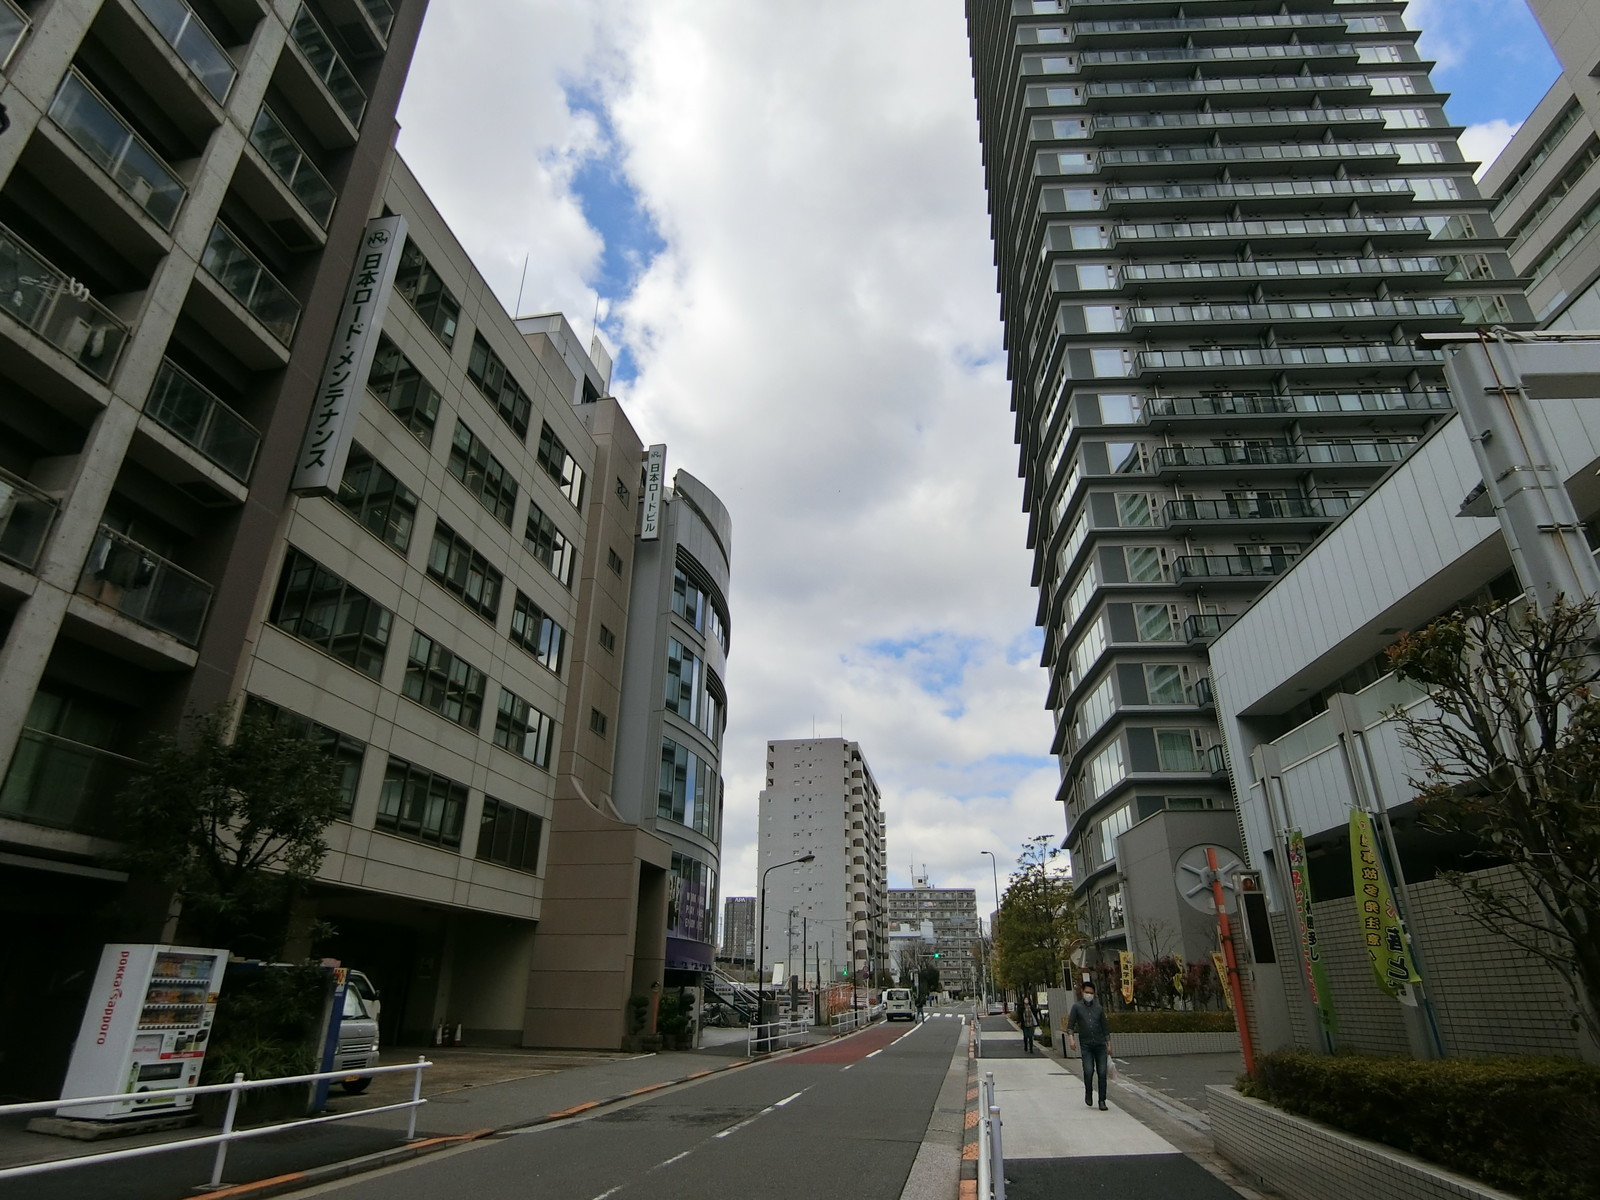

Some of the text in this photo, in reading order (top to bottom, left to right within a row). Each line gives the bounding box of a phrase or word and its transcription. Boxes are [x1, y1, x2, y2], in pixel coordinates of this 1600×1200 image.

[645, 463, 659, 532] 日本ロードビル
